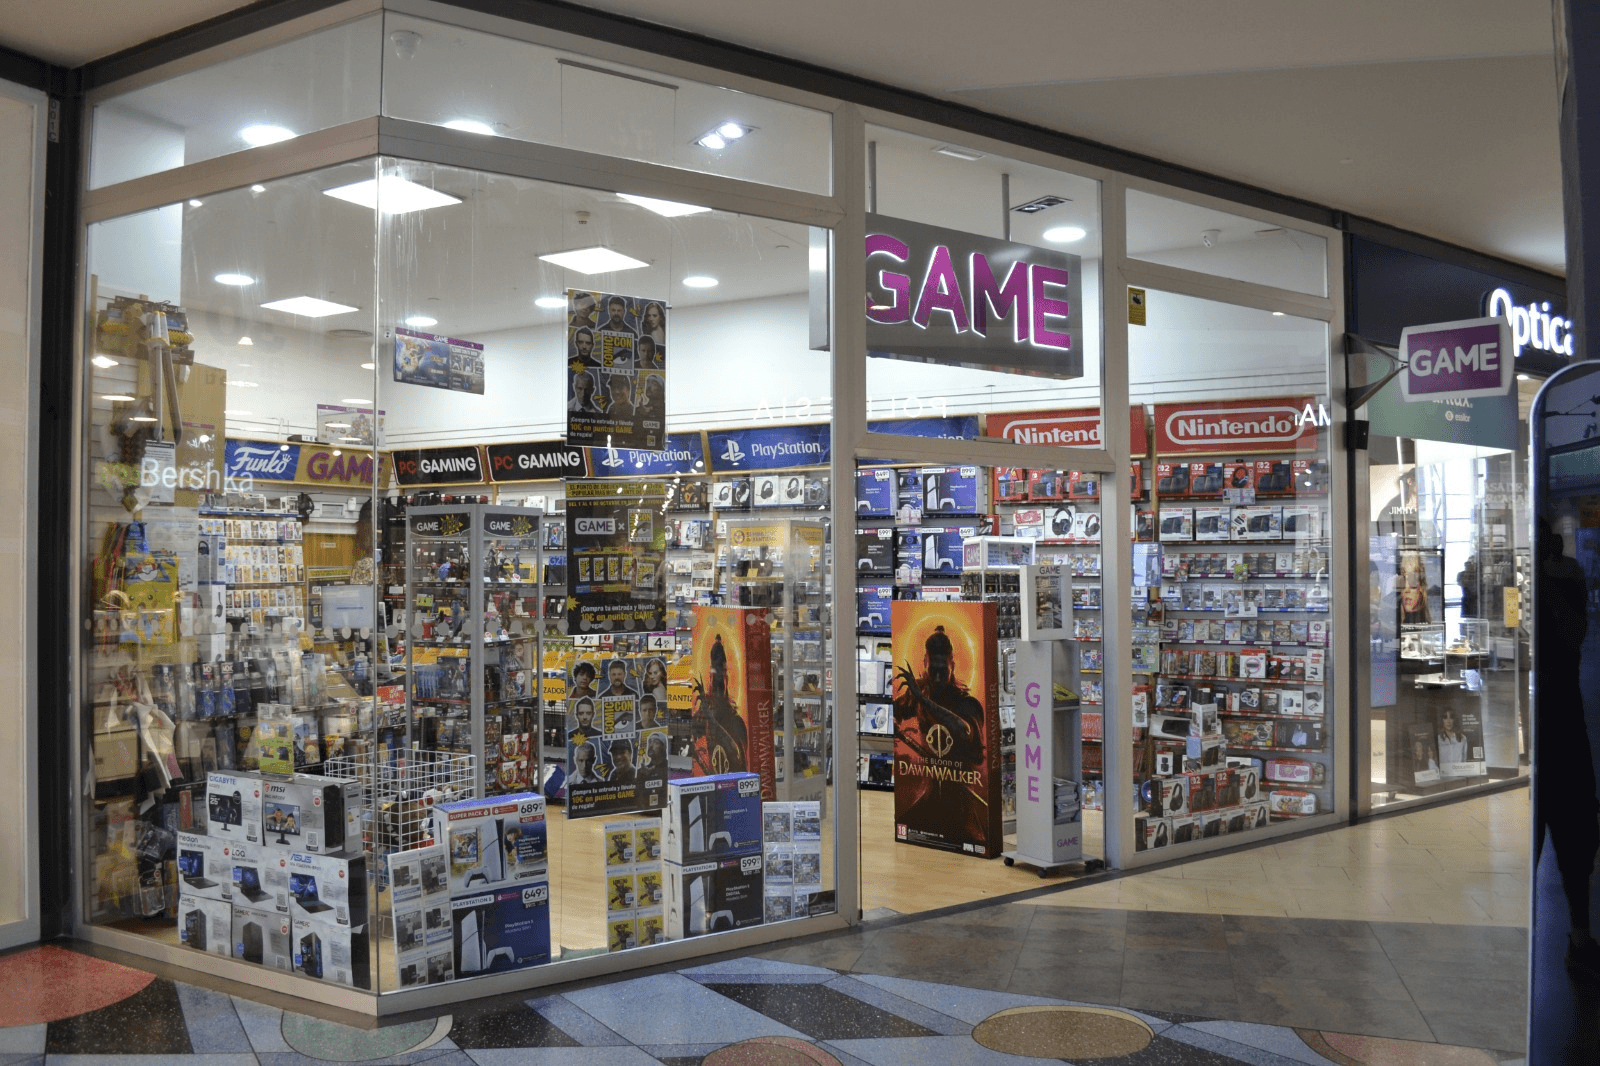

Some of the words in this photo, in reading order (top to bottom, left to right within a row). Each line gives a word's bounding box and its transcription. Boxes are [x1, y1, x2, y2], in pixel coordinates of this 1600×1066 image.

[866, 234, 1071, 350] GAME
[614, 337, 632, 348] CON
[604, 336, 613, 367] COMIC
[1409, 342, 1498, 377] GAME
[1178, 416, 1291, 437] Nintendo
[1013, 424, 1100, 444] Nintend
[751, 441, 820, 459] PlayStation
[230, 446, 288, 474] Funko
[494, 455, 513, 471] PC
[518, 452, 580, 469] GAMING
[629, 449, 691, 466] PlayStation
[307, 452, 385, 483] GAME
[398, 461, 416, 474] PC
[420, 457, 476, 473] GAMING
[140, 456, 254, 492] Bershka
[1388, 506, 1413, 515] JIMMY
[416, 522, 438, 532] GAME
[489, 521, 510, 531] GAME
[577, 520, 613, 532] GAME
[1169, 560, 1174, 568] 1
[1231, 560, 1237, 568] 2
[1280, 559, 1286, 568] 3
[1039, 566, 1061, 575] GAME
[654, 637, 662, 648] 4
[544, 687, 565, 695] ZADOS
[615, 700, 633, 712] CON
[604, 701, 615, 734] COMIC
[1024, 682, 1042, 803] GAME
[757, 699, 774, 800] DAWNWALKER
[930, 758, 953, 767] BLOOD
[954, 761, 963, 769] OF
[899, 760, 983, 787] DAWNWALKER
[209, 775, 237, 785] GIGABYTE
[739, 781, 755, 790] 899
[270, 785, 286, 793] msi
[681, 785, 710, 793] PLAYSTATION
[572, 796, 584, 804] 10€
[594, 793, 616, 802] puntos
[617, 790, 635, 798] GAME
[520, 803, 539, 813] 689
[449, 812, 467, 820] SUPER
[897, 825, 907, 836] 18
[1056, 837, 1079, 847] GAME
[232, 850, 245, 858] LOQ
[290, 853, 312, 864] ASUS
[683, 864, 712, 873] PLAYSTATION
[742, 858, 757, 868] 599
[524, 888, 542, 899] 649
[452, 898, 488, 907] PLAYSTATION
